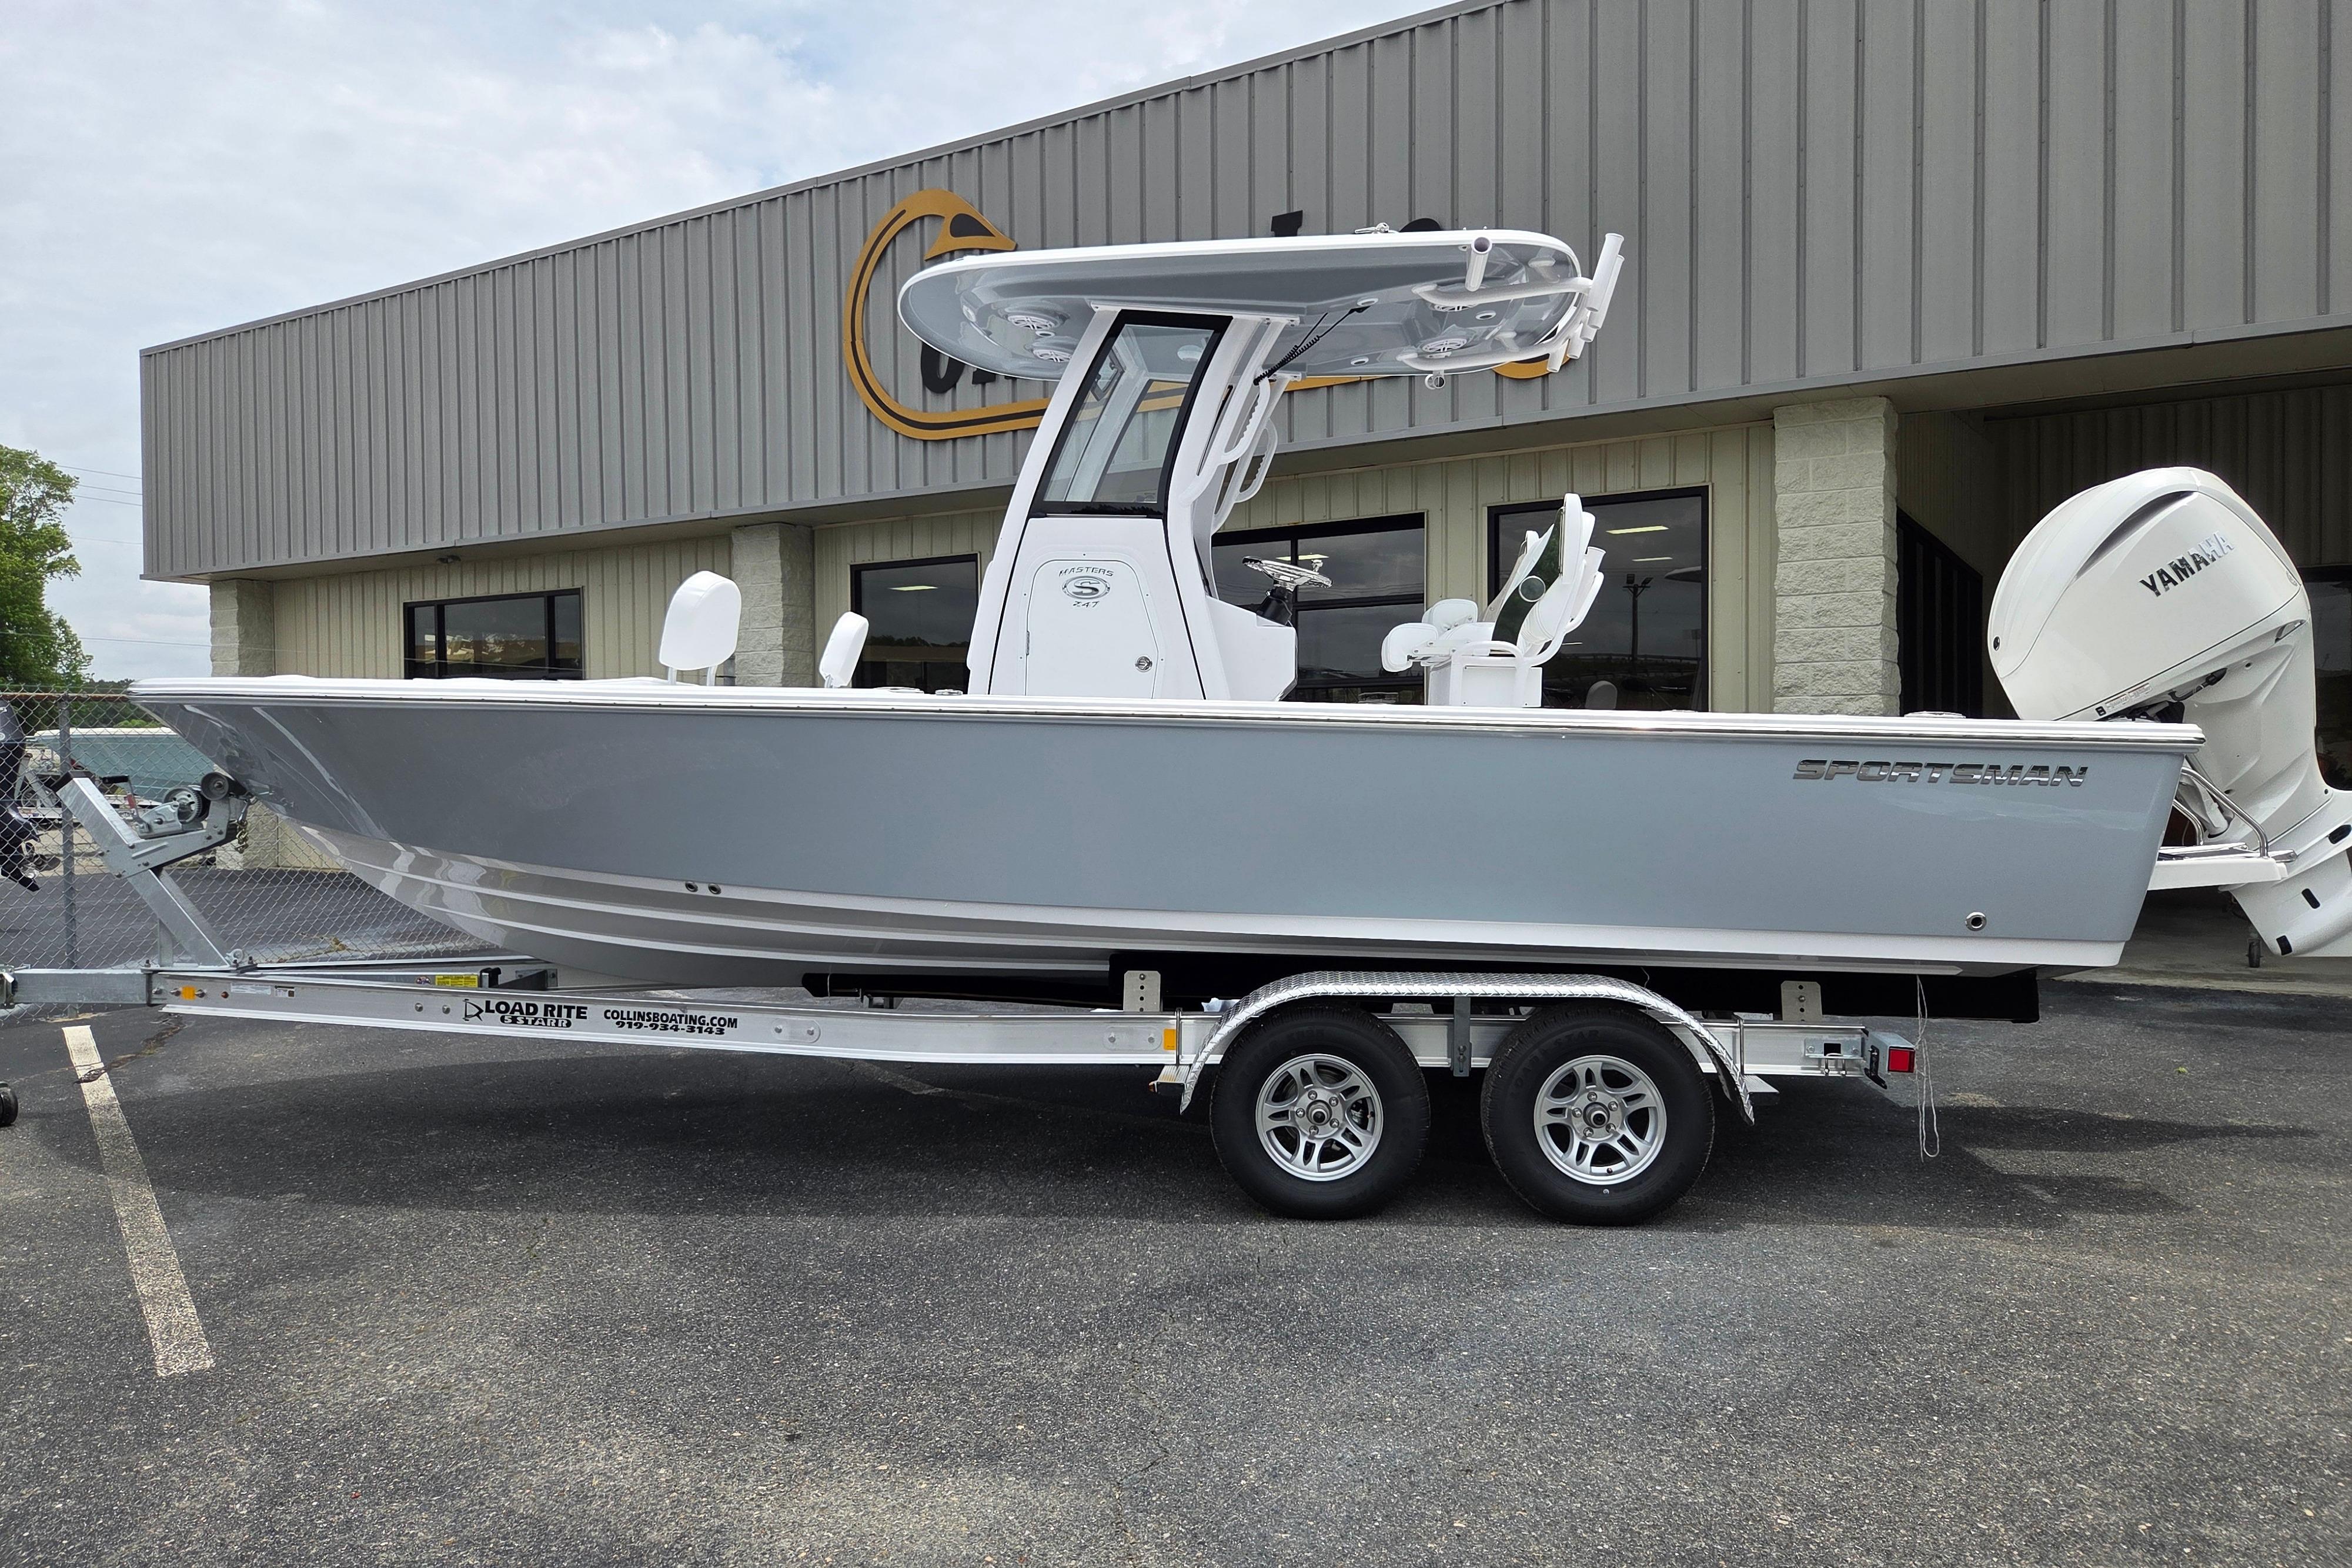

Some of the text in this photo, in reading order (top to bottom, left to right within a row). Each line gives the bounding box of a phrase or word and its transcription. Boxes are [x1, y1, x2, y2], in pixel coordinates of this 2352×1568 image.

[1059, 567, 1114, 576] MASTERS
[2139, 531, 2234, 597] YAMAHA
[1793, 759, 2088, 787] SPORTSMAN
[485, 1000, 587, 1019] LOAD RITE
[604, 1009, 737, 1028] COLLINSBOATING.COM
[516, 1017, 568, 1027] STARR
[616, 1021, 724, 1035] 919-934-3143
